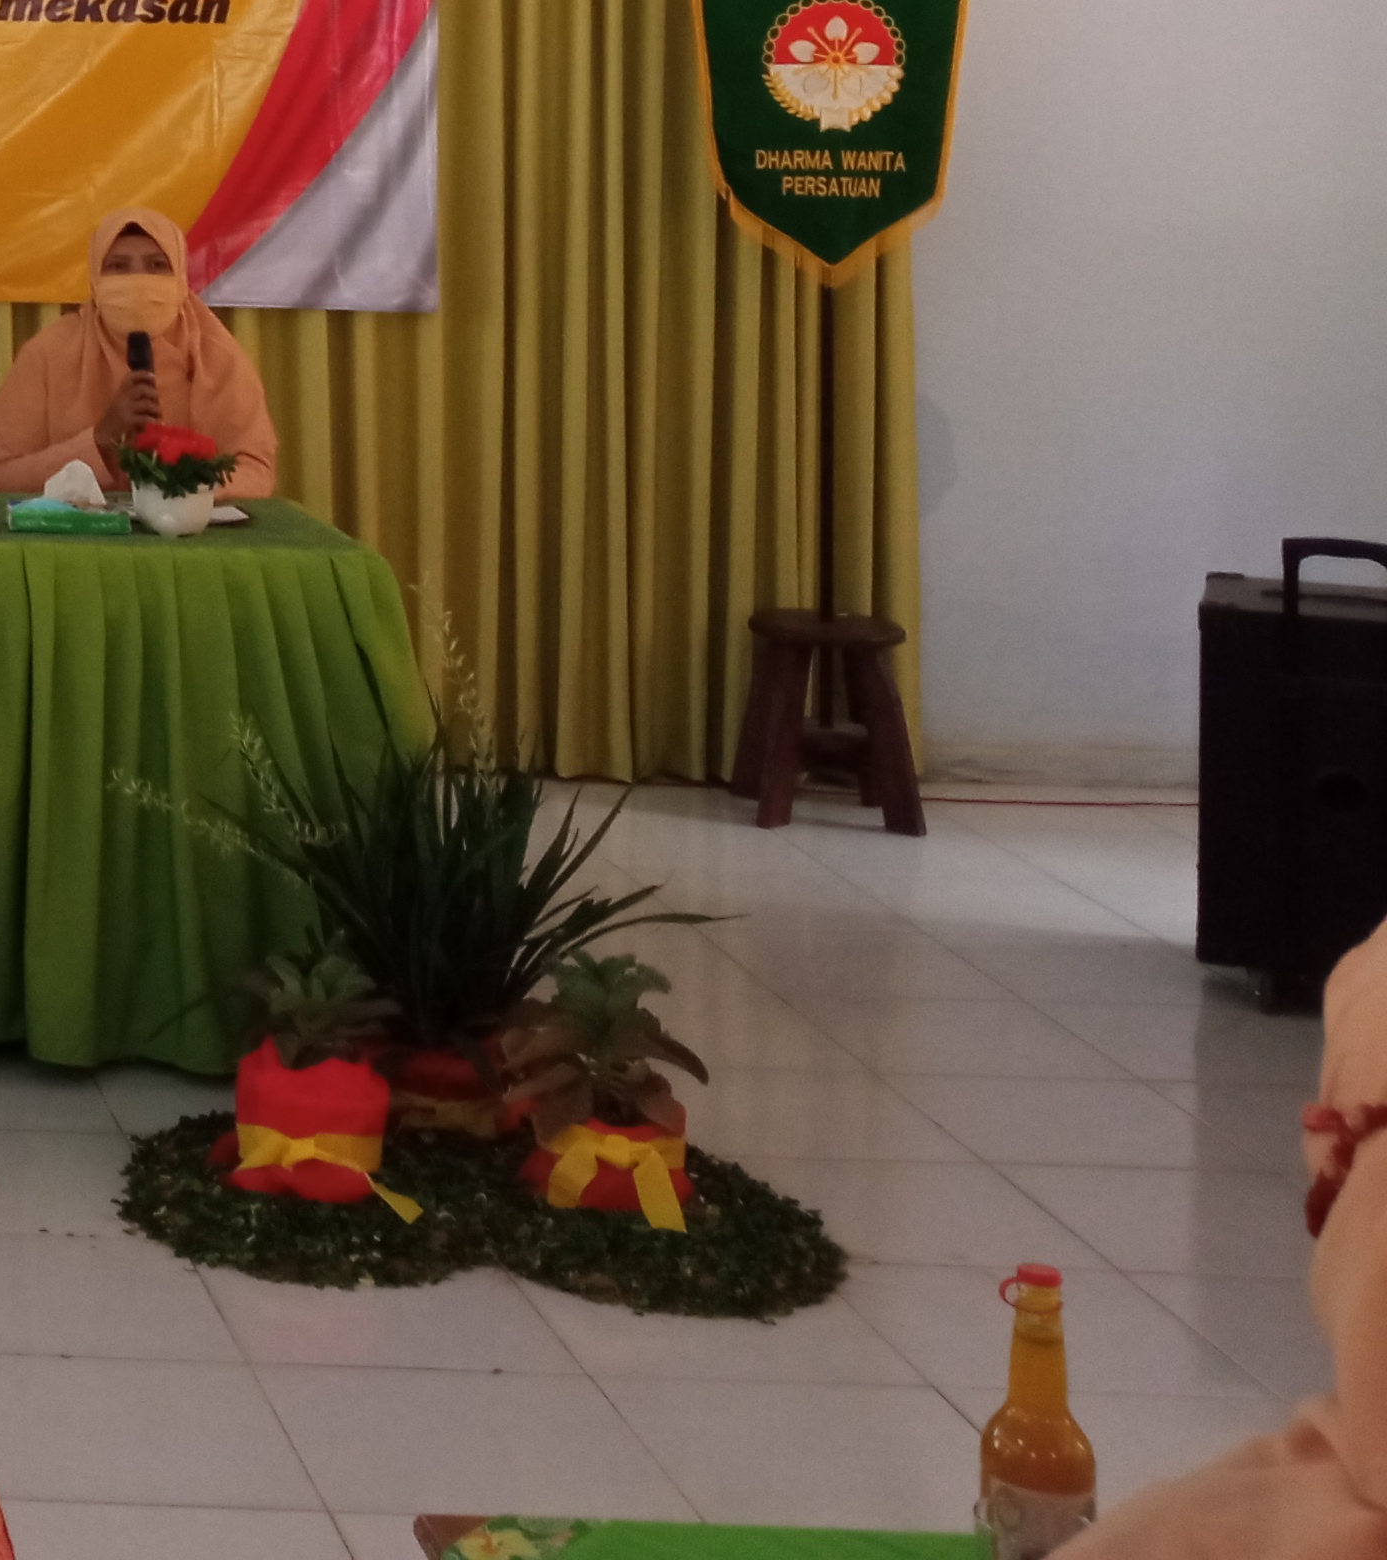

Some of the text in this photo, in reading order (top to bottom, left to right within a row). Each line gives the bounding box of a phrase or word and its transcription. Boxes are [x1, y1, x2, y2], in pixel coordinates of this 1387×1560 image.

[756, 150, 905, 171] DHARMA WANITA
[782, 176, 880, 198] PERSATUAN
